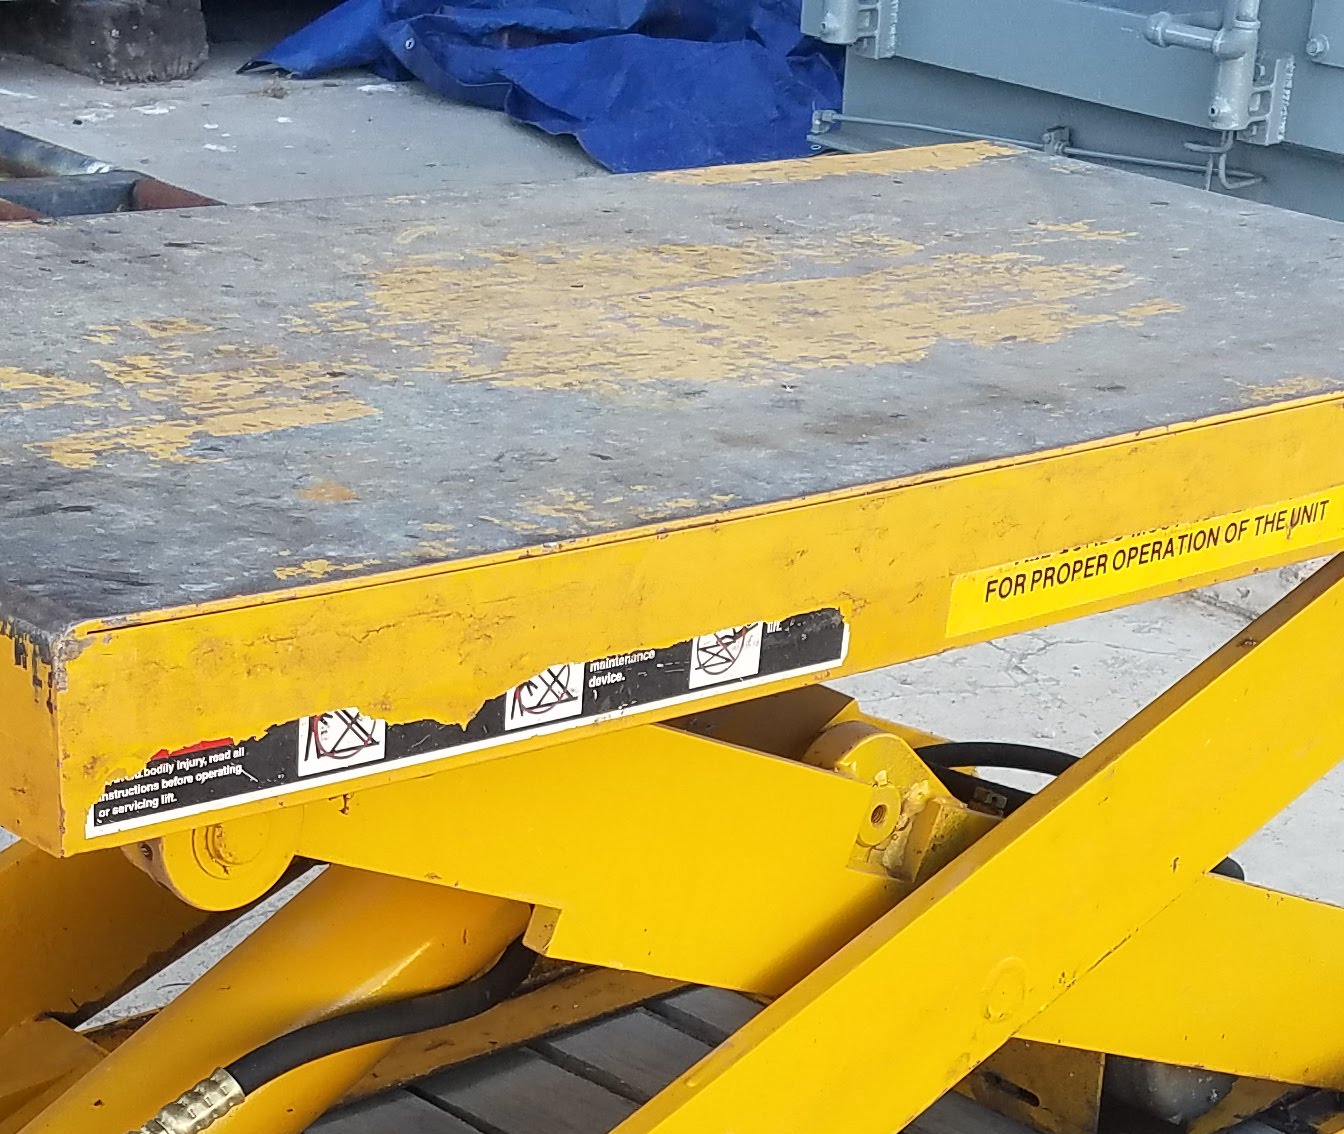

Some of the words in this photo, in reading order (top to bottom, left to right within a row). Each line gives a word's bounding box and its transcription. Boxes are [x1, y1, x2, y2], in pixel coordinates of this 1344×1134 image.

[985, 573, 1026, 603] FOR
[1030, 553, 1109, 592] PROPER
[1112, 526, 1220, 571] OPERATION
[1224, 519, 1250, 544] OF
[1255, 510, 1287, 536] THE
[1290, 500, 1330, 528] UNIT
[589, 649, 656, 673] maintenance
[588, 672, 626, 688] device.
[144, 762, 174, 777] bodily
[176, 756, 208, 772] injury,
[208, 750, 231, 763] read
[233, 747, 245, 758] all
[161, 774, 194, 789] before
[196, 764, 243, 784] operating
[98, 808, 111, 818] or
[112, 797, 159, 815] servicing
[161, 792, 178, 805] lift.
